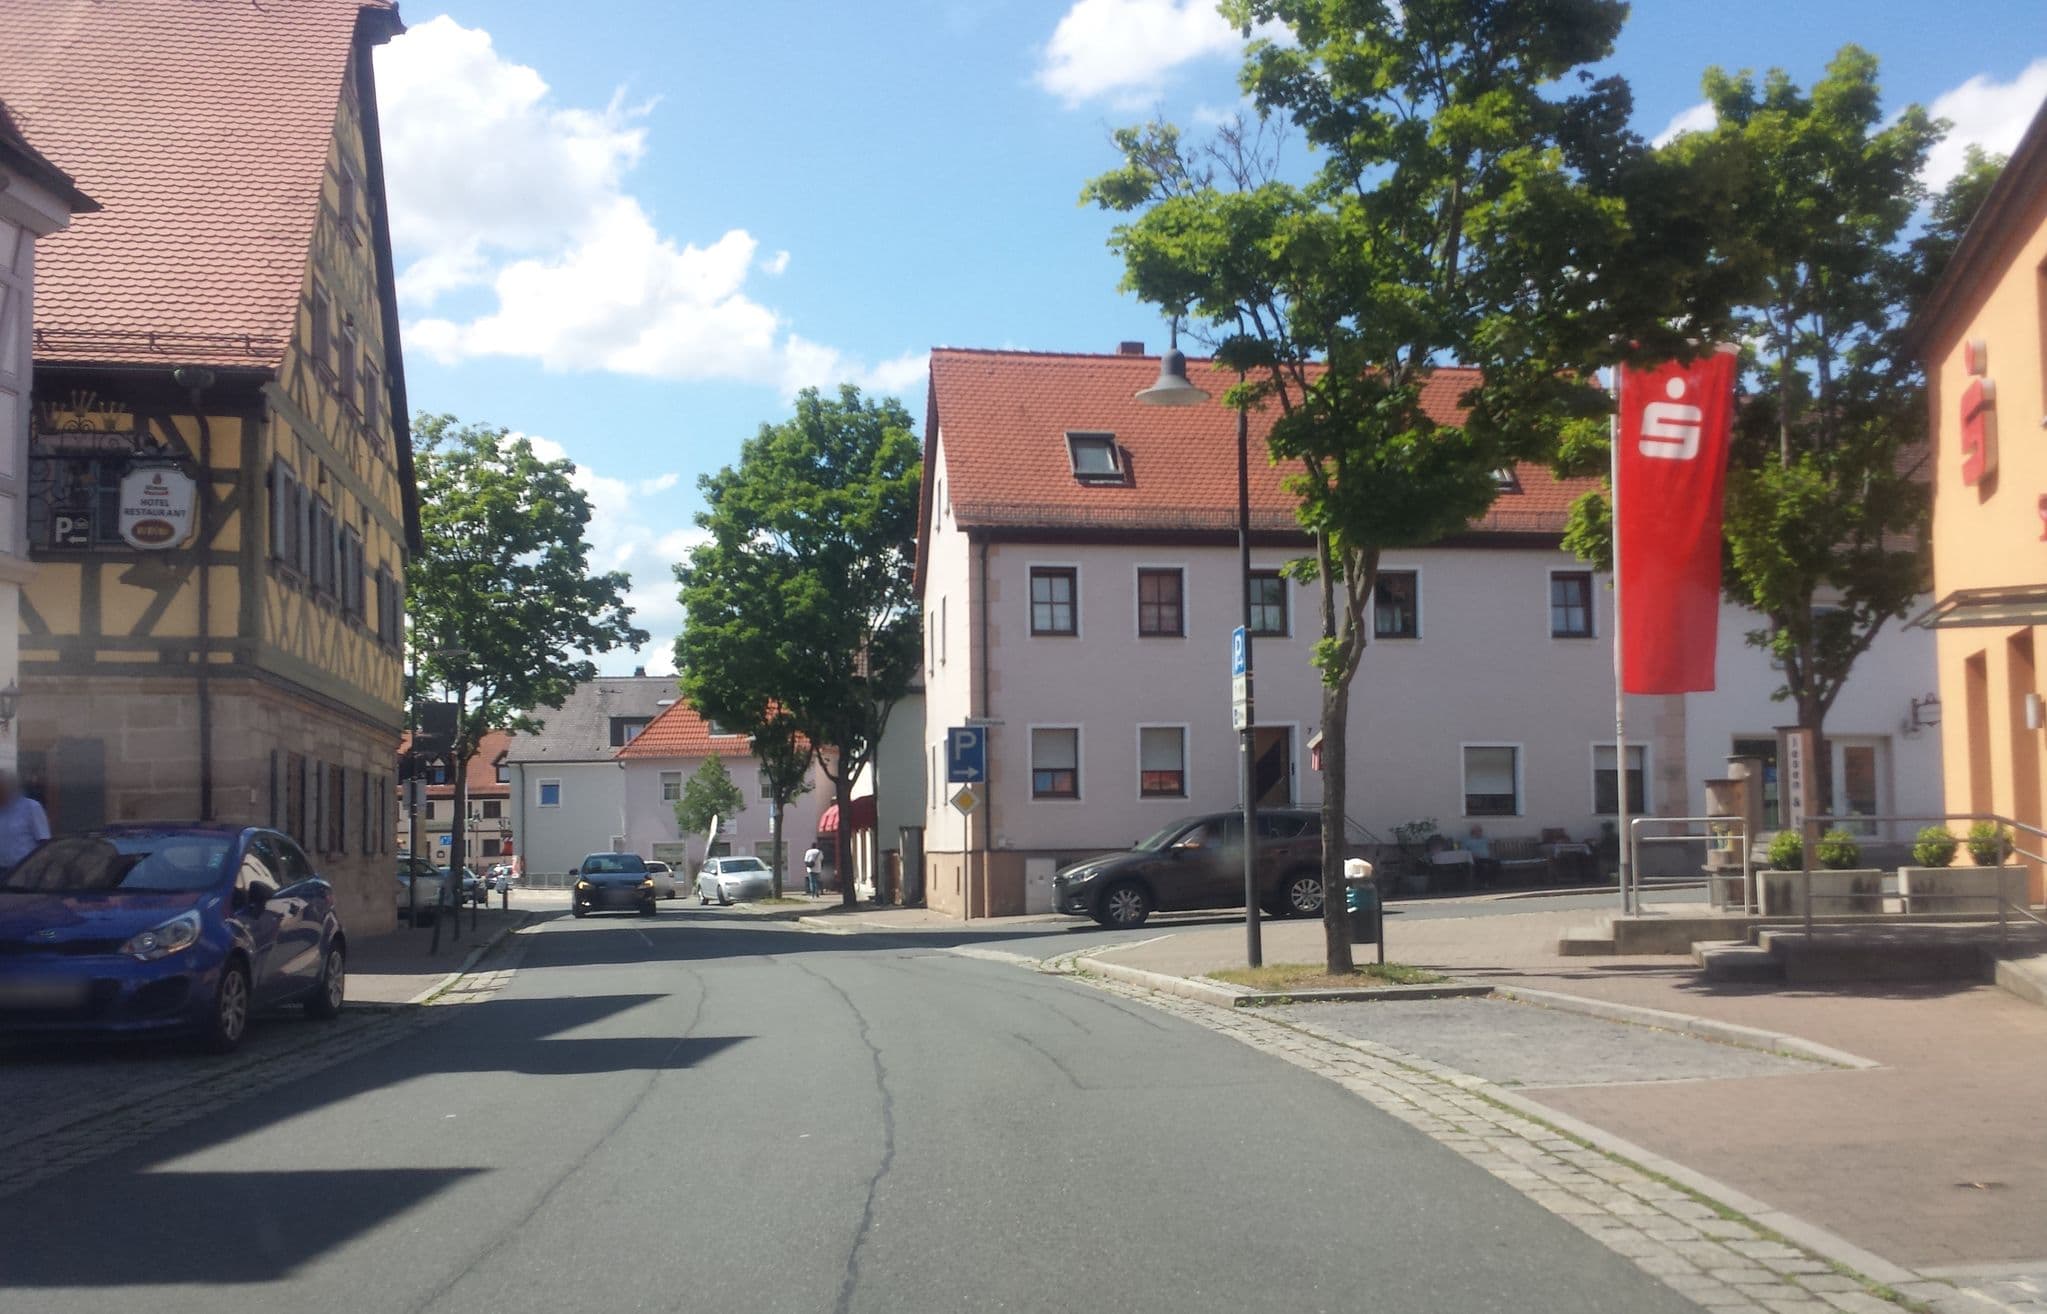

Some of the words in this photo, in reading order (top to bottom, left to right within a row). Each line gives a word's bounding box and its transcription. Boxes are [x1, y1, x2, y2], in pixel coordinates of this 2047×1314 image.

[140, 498, 169, 507] HOTEL
[123, 508, 187, 517] RESTAURANT
[56, 517, 72, 543] P
[955, 731, 977, 761] P
